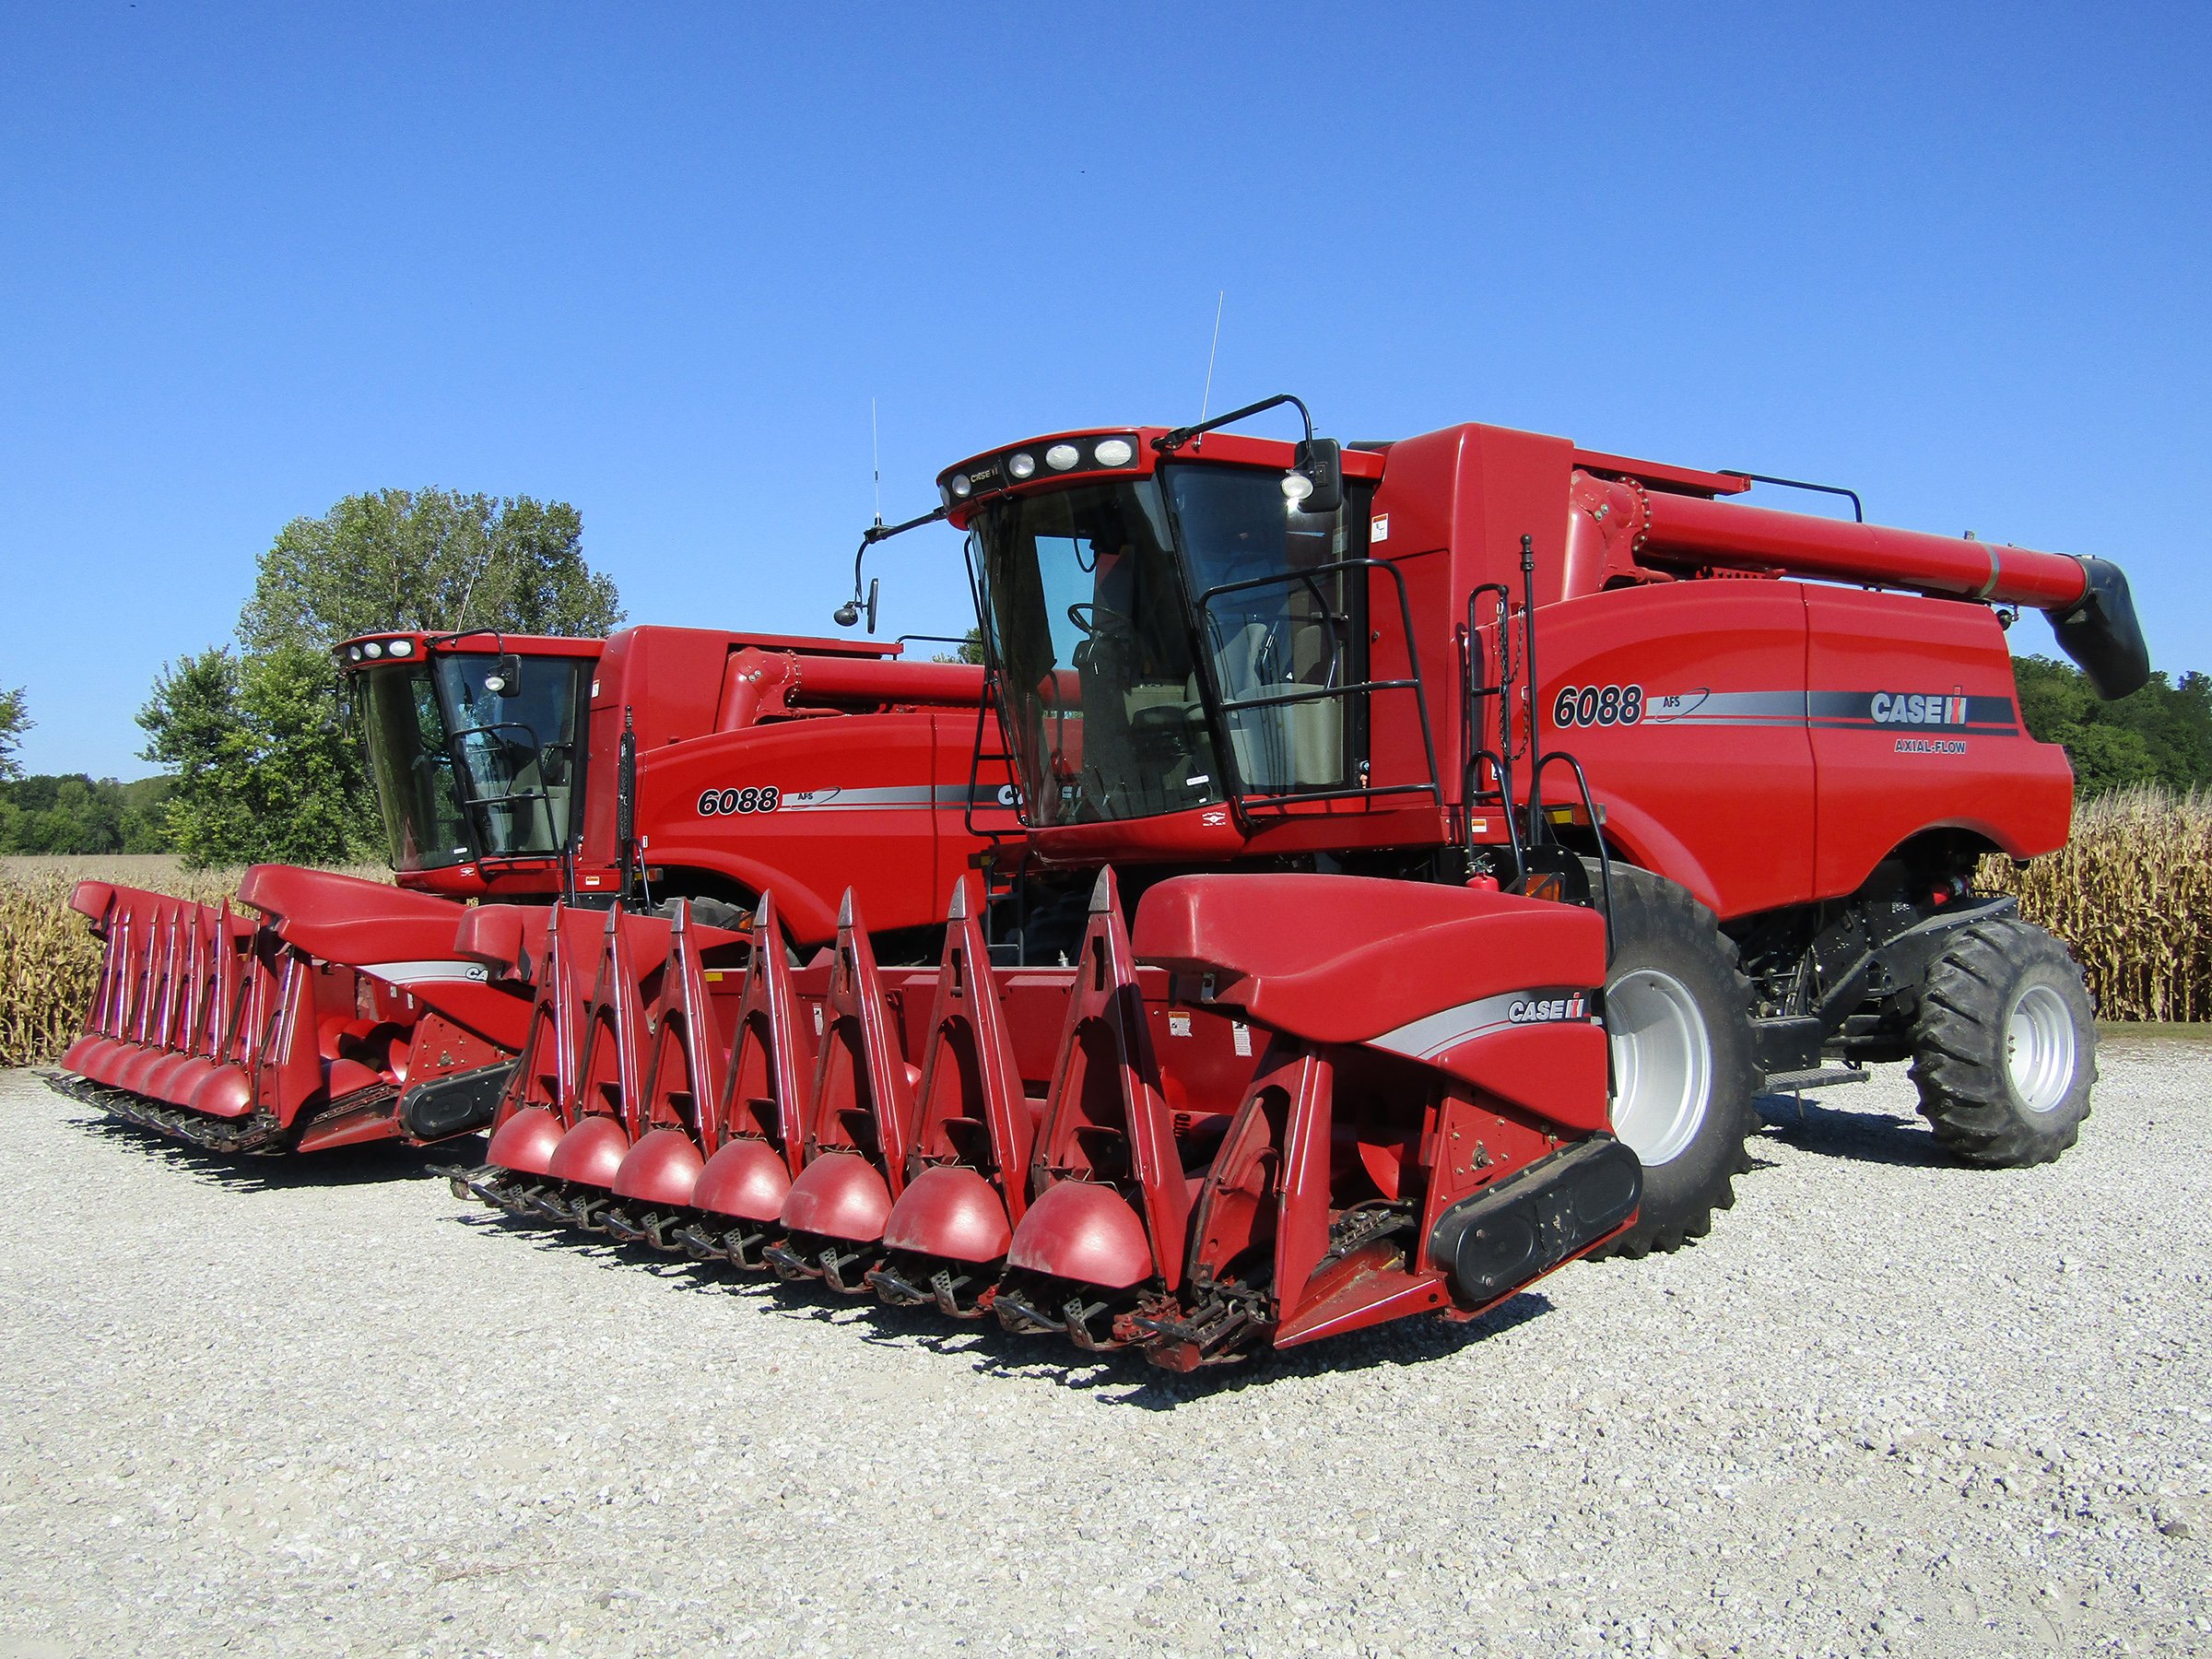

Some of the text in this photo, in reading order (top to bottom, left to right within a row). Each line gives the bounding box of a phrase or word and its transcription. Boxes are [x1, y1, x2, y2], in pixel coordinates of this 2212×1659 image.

[1553, 684, 1680, 729] 6088 AFS
[1870, 692, 1943, 724] CASE
[1894, 738, 1967, 755] AXIAL-FLOW
[697, 785, 814, 817] 6088 AFS
[1509, 1000, 1565, 1022] CASE
